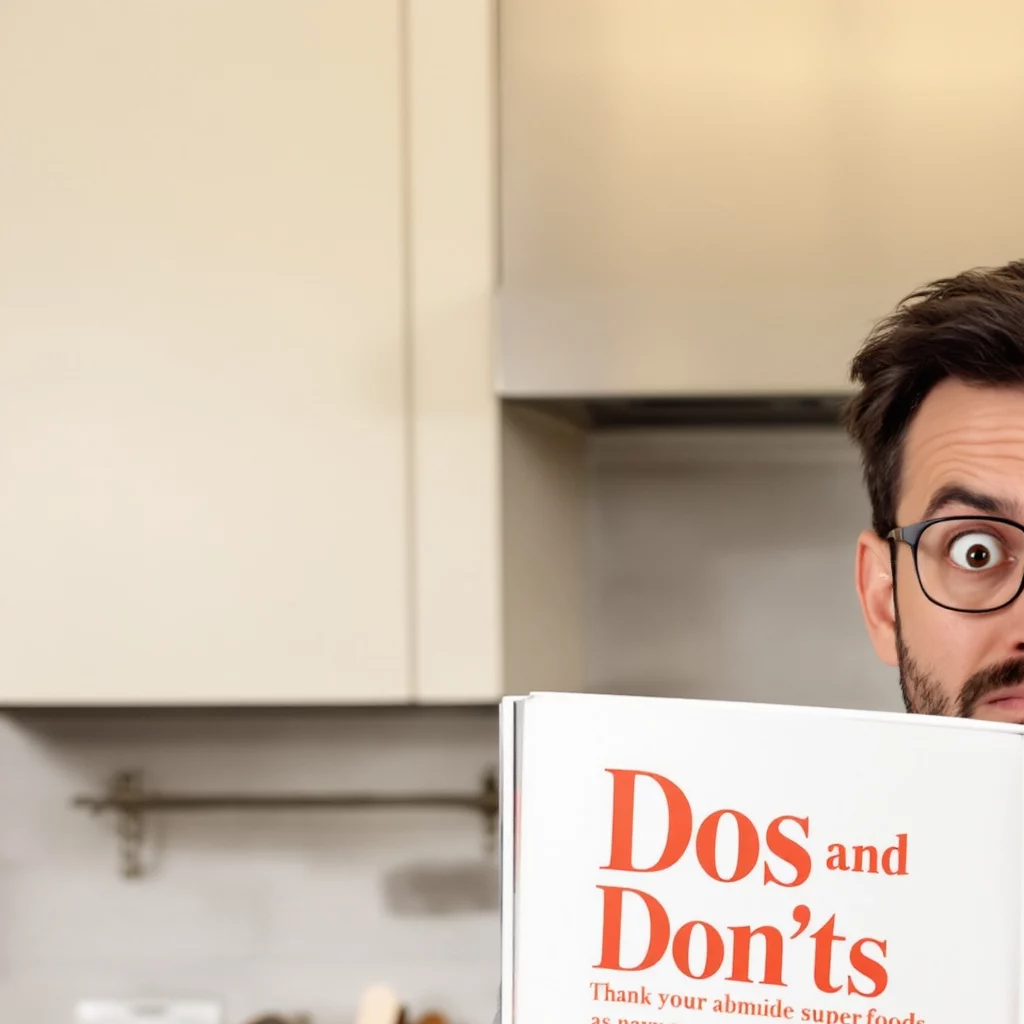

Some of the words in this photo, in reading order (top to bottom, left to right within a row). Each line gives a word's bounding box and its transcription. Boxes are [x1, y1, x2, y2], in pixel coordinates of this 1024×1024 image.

[599, 768, 812, 887] Dos
[826, 833, 909, 875] and
[590, 982, 652, 1005] Thank
[658, 993, 707, 1010] your
[592, 884, 888, 998] Don'ts
